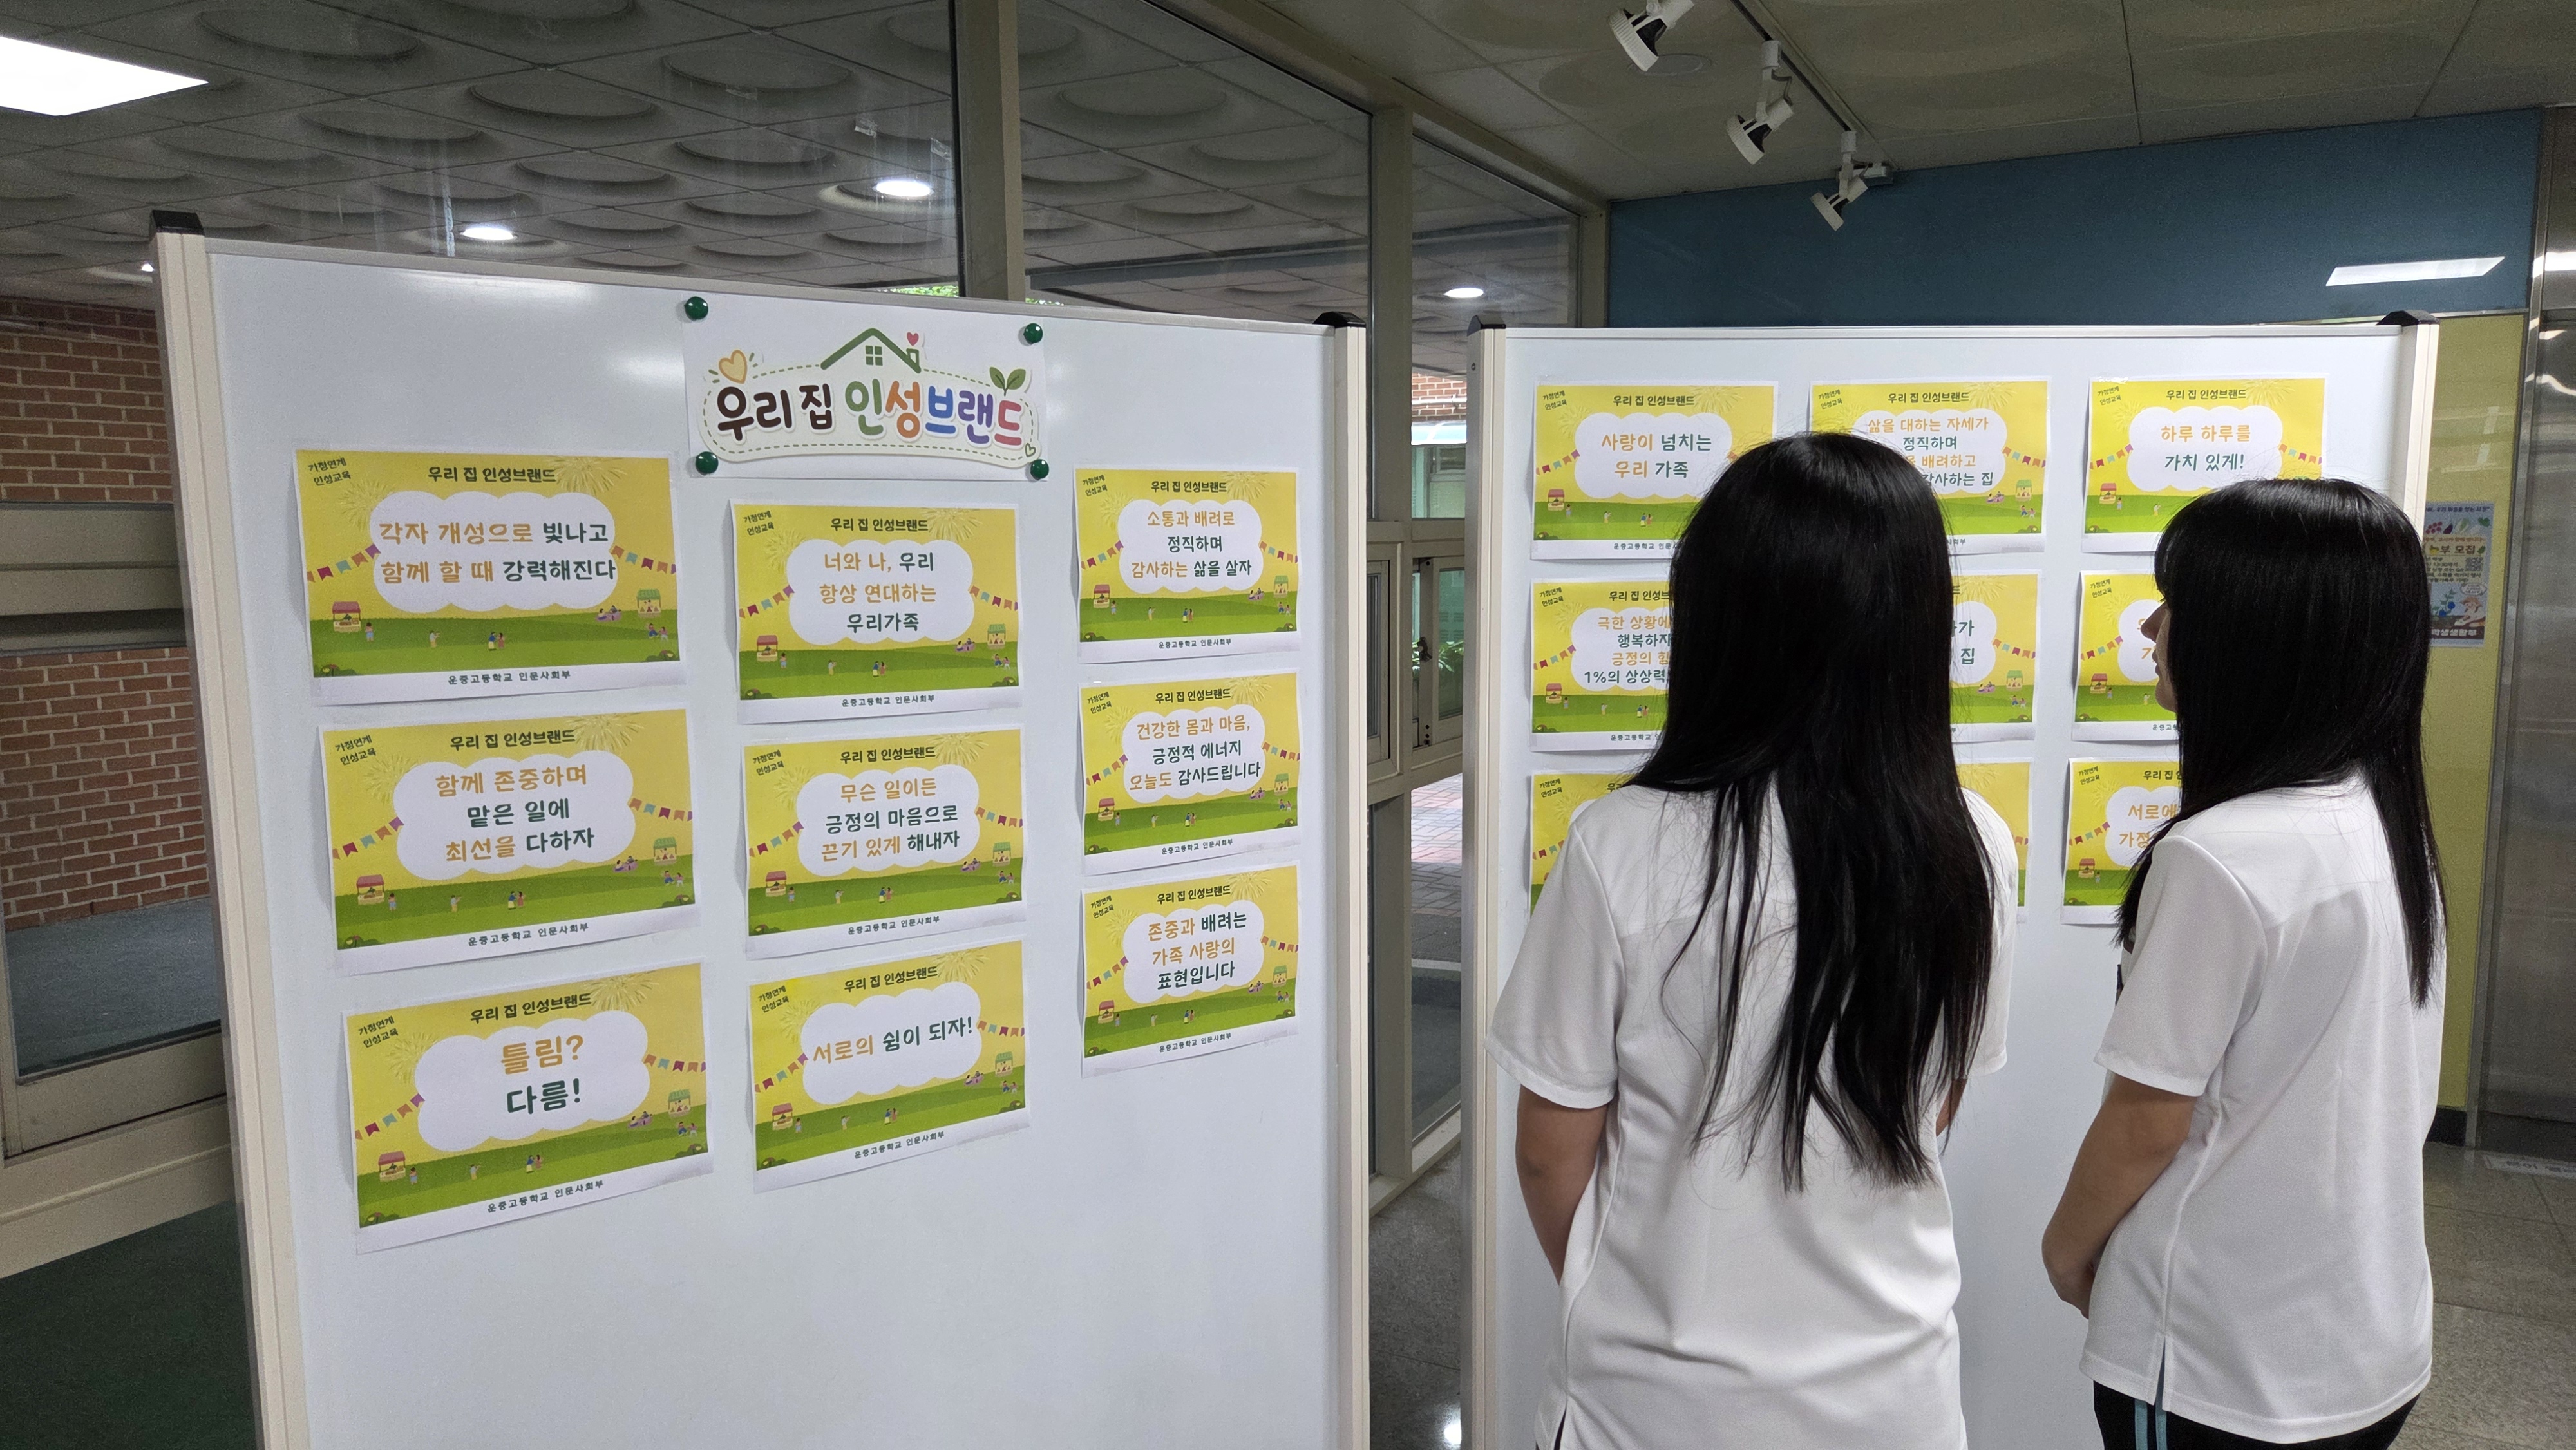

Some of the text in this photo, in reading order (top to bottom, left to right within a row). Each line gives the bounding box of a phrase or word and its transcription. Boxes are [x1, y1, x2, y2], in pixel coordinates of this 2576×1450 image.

[1613, 395, 1694, 406] 우리 집 인성브랜드
[1888, 392, 1969, 403] 우리 집 인성브랜드
[2166, 390, 2246, 400] 우리 집 인성브랜드
[845, 379, 1023, 446] 인성브랜드
[1868, 417, 1988, 433] 삶을 대하는 자세가
[2161, 425, 2250, 442] 하루 하루를
[1602, 434, 1711, 451] 사랑이 넘치는
[1903, 436, 1956, 451] 정직하며
[1615, 461, 1688, 478] 우리 가족
[1922, 455, 1976, 468] 배려하고
[2165, 453, 2244, 471] 가치 있게!
[428, 467, 556, 482] 우리 집 인성브랜드
[1982, 472, 1993, 485] 집
[1151, 481, 1227, 493] 우리 집 인성브랜드
[831, 518, 928, 532] 우리 집 인성브랜드
[1148, 511, 1235, 527] 소통과 배려로
[379, 522, 608, 545] 각자 개성으로 빛나고
[1168, 536, 1222, 552] 정직하며
[2454, 545, 2475, 554] 모집
[825, 552, 933, 572] 너와 나, 우리
[1132, 560, 1251, 578] 감사하는 삶을 살자
[381, 560, 616, 583] 함께 할 때 강력해진다
[819, 583, 936, 604] 항상 연대하는
[1609, 590, 1670, 601] 우리 집 인성브
[847, 613, 919, 633] 우리가족
[1598, 616, 1671, 630] 극한 상황에
[1612, 652, 1671, 666] 긍정의 힘
[1961, 648, 1975, 664] 집
[1584, 670, 1665, 683] 1%의 상상력
[1155, 688, 1231, 704] 우리 집 인성브랜드
[1137, 715, 1249, 740] 건강한 몸과 마음,
[450, 730, 575, 751] 우리 집 인성브랜드
[840, 747, 936, 764] 우리 집 인성브랜드
[1153, 740, 1240, 765] 긍정적 에너지
[435, 764, 586, 797] 함께 존중하며
[1130, 761, 1261, 790] 오늘도 감사드립니다
[2143, 771, 2161, 780] 우리
[2164, 771, 2173, 780] 집
[841, 778, 936, 803] 무슨 일이든
[468, 798, 569, 827] 맡은 일에
[826, 805, 958, 834] 긍정의 마음으로
[2128, 804, 2178, 820] 서로에
[446, 827, 594, 862] 최선을 다하자
[822, 830, 960, 862] 끈기 있게 해내자
[1157, 885, 1230, 905] 우리 집 인성브랜드
[1148, 912, 1246, 941] 존중과 배려는
[1153, 937, 1234, 966] 가족 사랑의
[844, 966, 938, 992] 우리 집 인성브랜드
[1158, 961, 1235, 990] 표현입니다
[471, 993, 591, 1024] 우리 집 인성브랜드
[813, 1017, 972, 1064] 서로의 쉼이 되자!
[501, 1035, 583, 1075] 틀림?
[507, 1078, 580, 1114] 다름!
